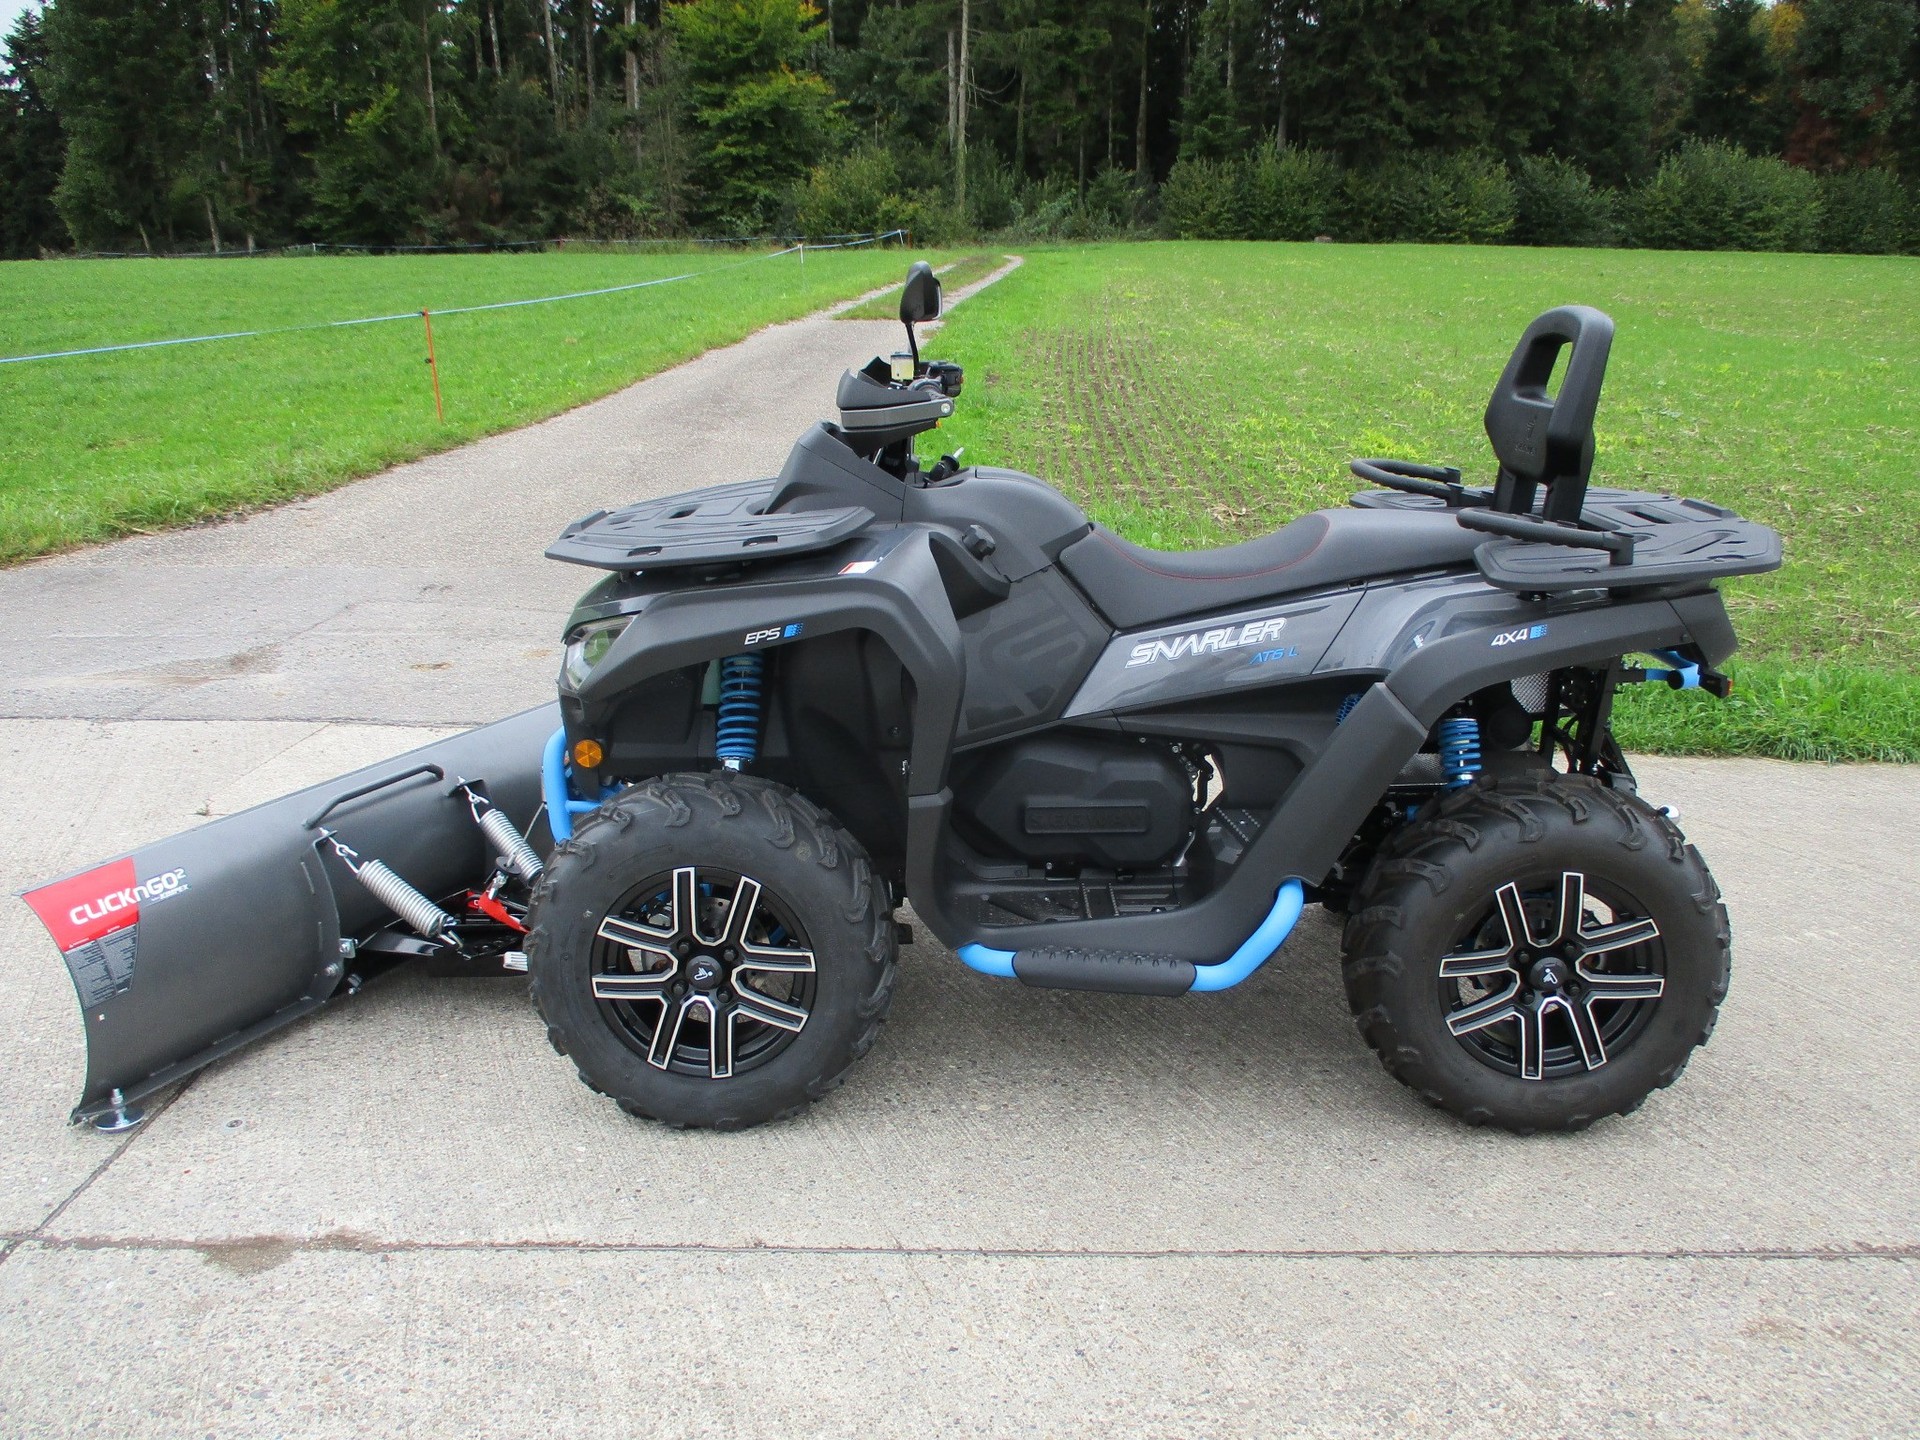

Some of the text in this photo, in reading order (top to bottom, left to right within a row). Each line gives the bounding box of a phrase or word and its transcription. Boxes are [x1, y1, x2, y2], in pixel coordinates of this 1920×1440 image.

[744, 627, 781, 645] EPS
[1125, 617, 1287, 668] SNARLER
[1289, 645, 1298, 657] L
